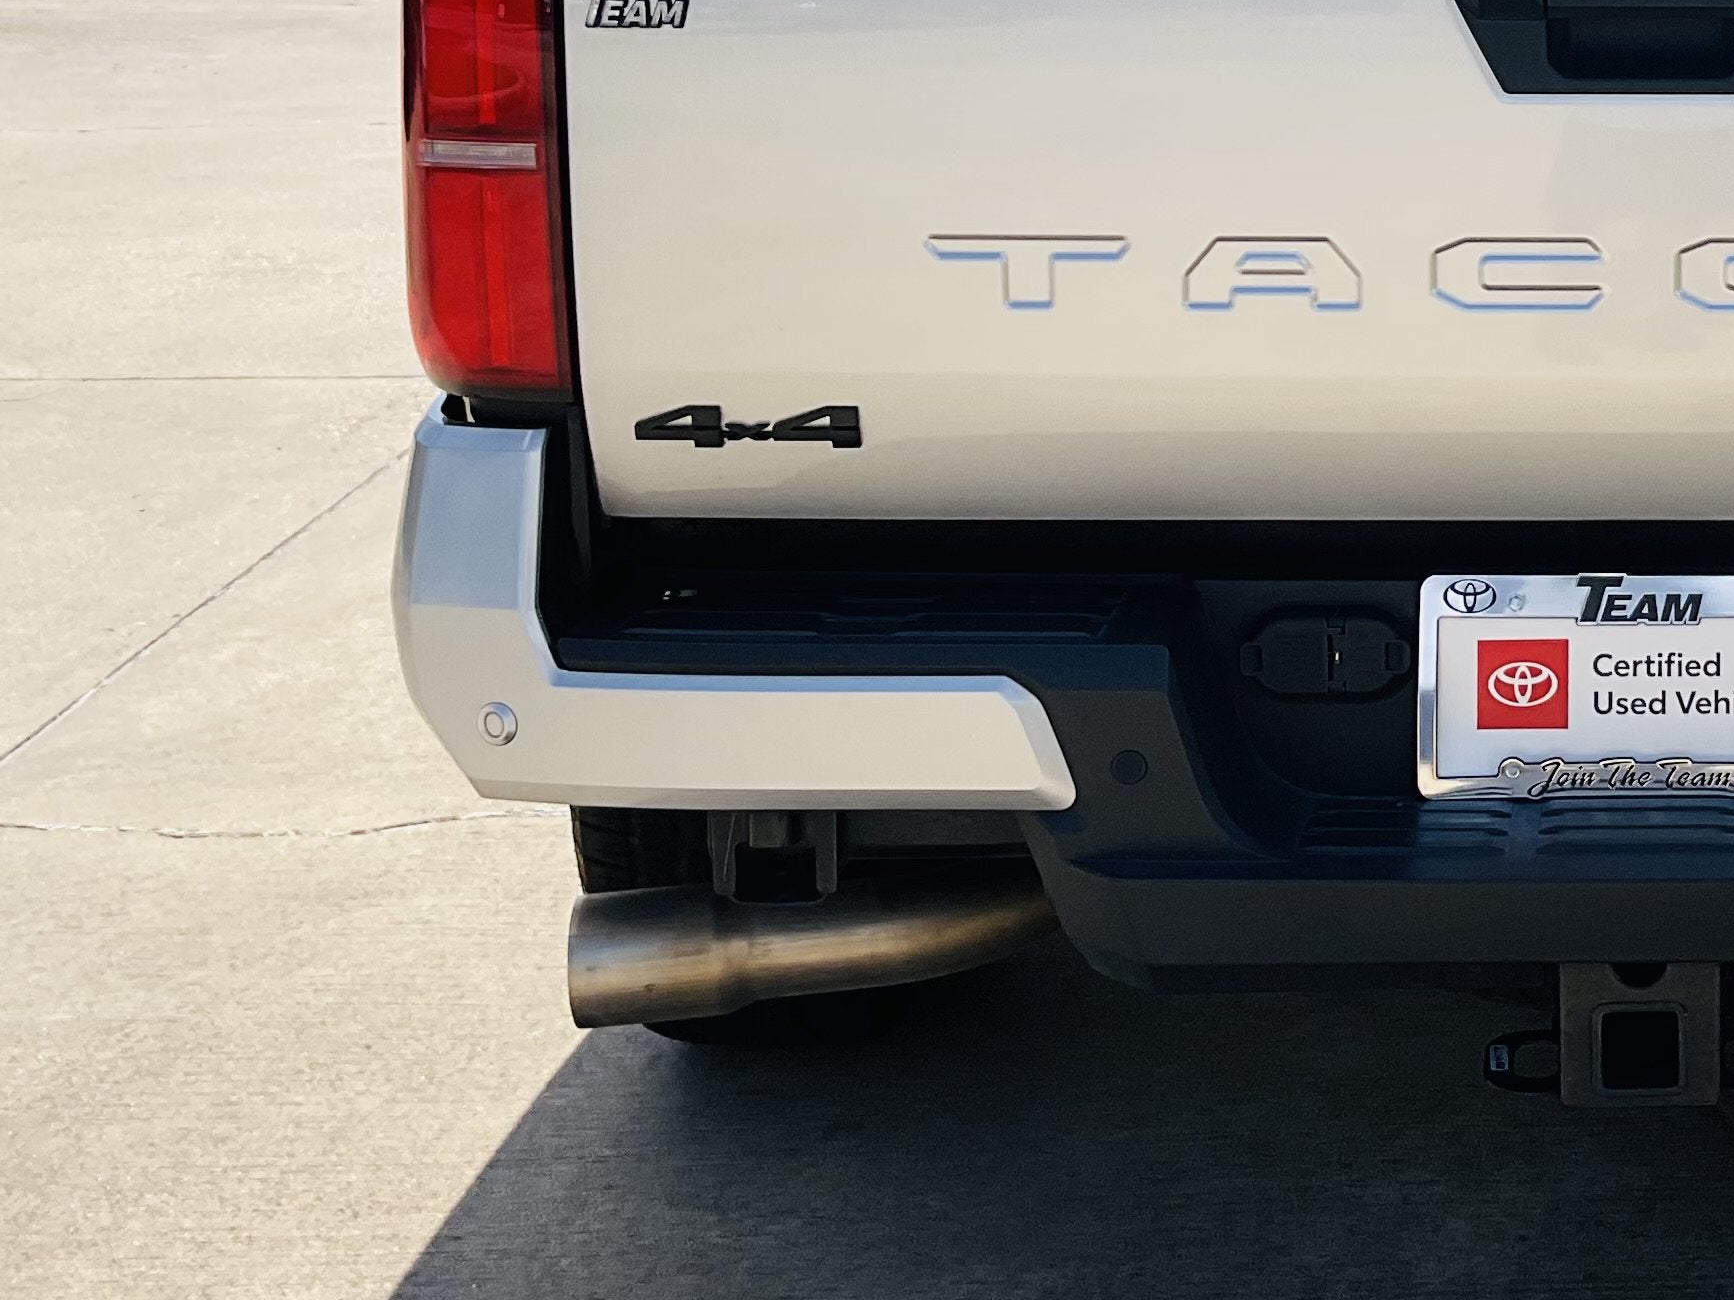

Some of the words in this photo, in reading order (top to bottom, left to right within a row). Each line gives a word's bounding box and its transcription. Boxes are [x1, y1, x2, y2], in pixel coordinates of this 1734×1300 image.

[634, 404, 862, 448] 4x4
[1576, 574, 1703, 623] TEAM
[1592, 652, 1721, 677] Certified
[1593, 690, 1666, 714] Used
[1527, 761, 1597, 797] Join
[1600, 760, 1652, 789] The
